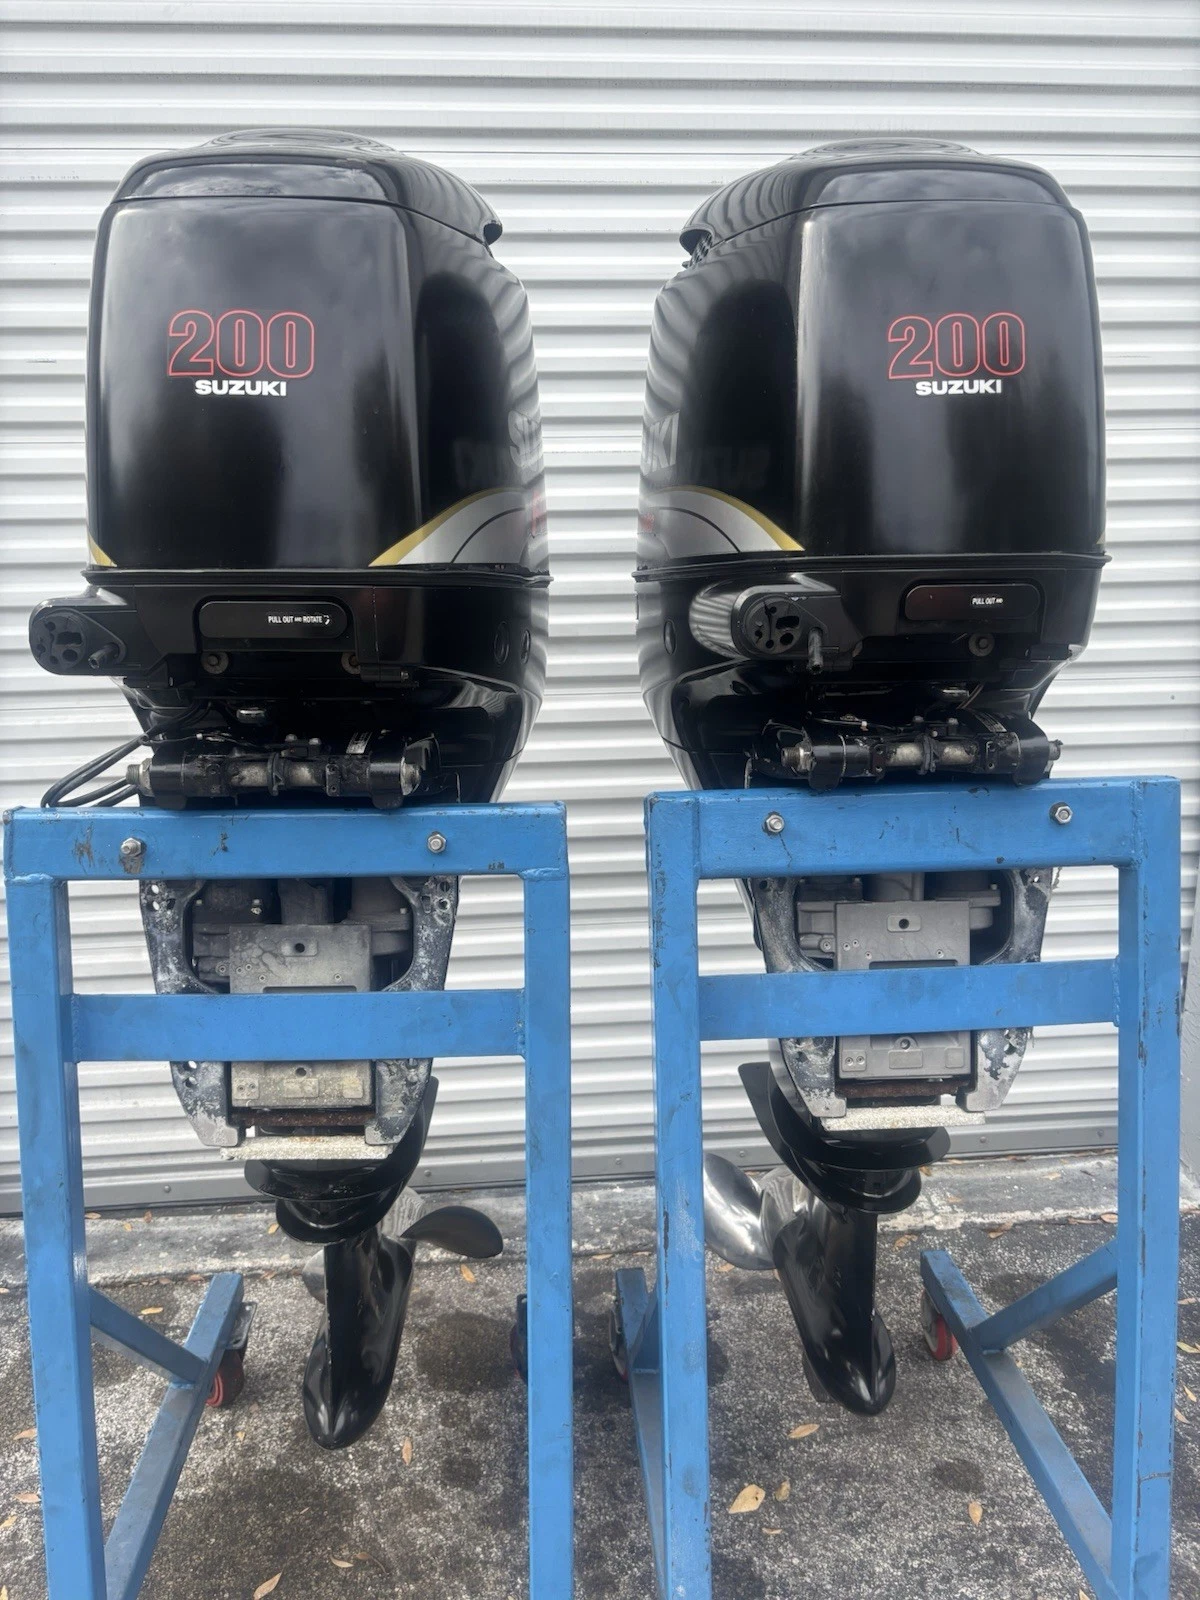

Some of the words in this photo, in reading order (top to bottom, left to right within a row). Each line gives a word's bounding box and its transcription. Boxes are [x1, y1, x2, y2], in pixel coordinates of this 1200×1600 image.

[168, 308, 315, 378] 200
[887, 312, 1026, 379] 200
[194, 379, 287, 396] SUZUKI
[915, 379, 1002, 396] SUZUKI
[972, 597, 985, 605] PULL
[985, 597, 996, 605] OUT
[268, 615, 282, 624] PULL
[282, 615, 294, 624] OUT
[302, 615, 323, 624] ROTATE
